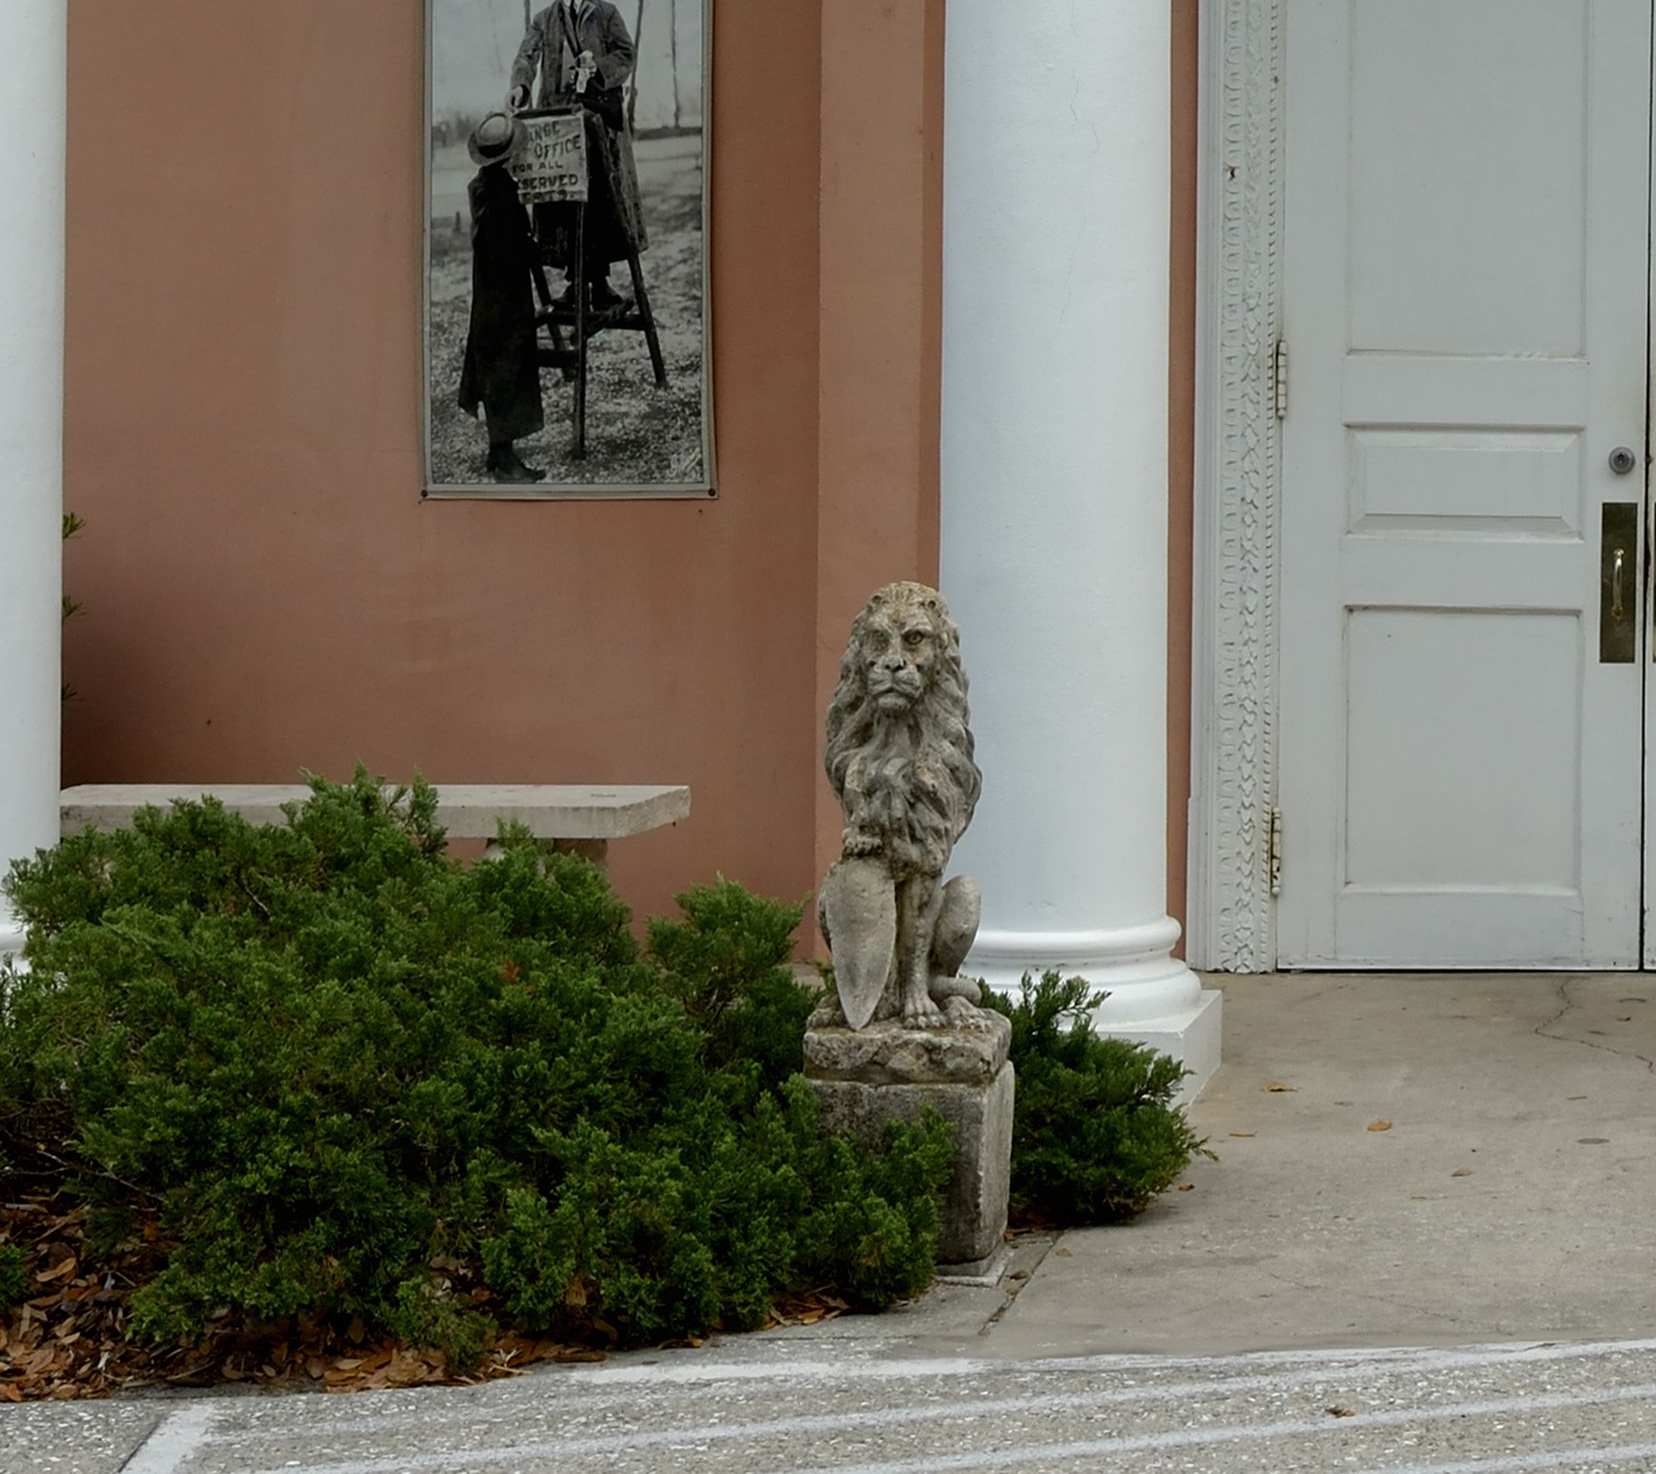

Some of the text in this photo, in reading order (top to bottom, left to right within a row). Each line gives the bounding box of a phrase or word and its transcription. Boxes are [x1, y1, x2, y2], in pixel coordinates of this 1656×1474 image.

[534, 133, 582, 160] OFFICE
[512, 160, 563, 173] FOR ALL
[520, 173, 579, 190] SERVED
